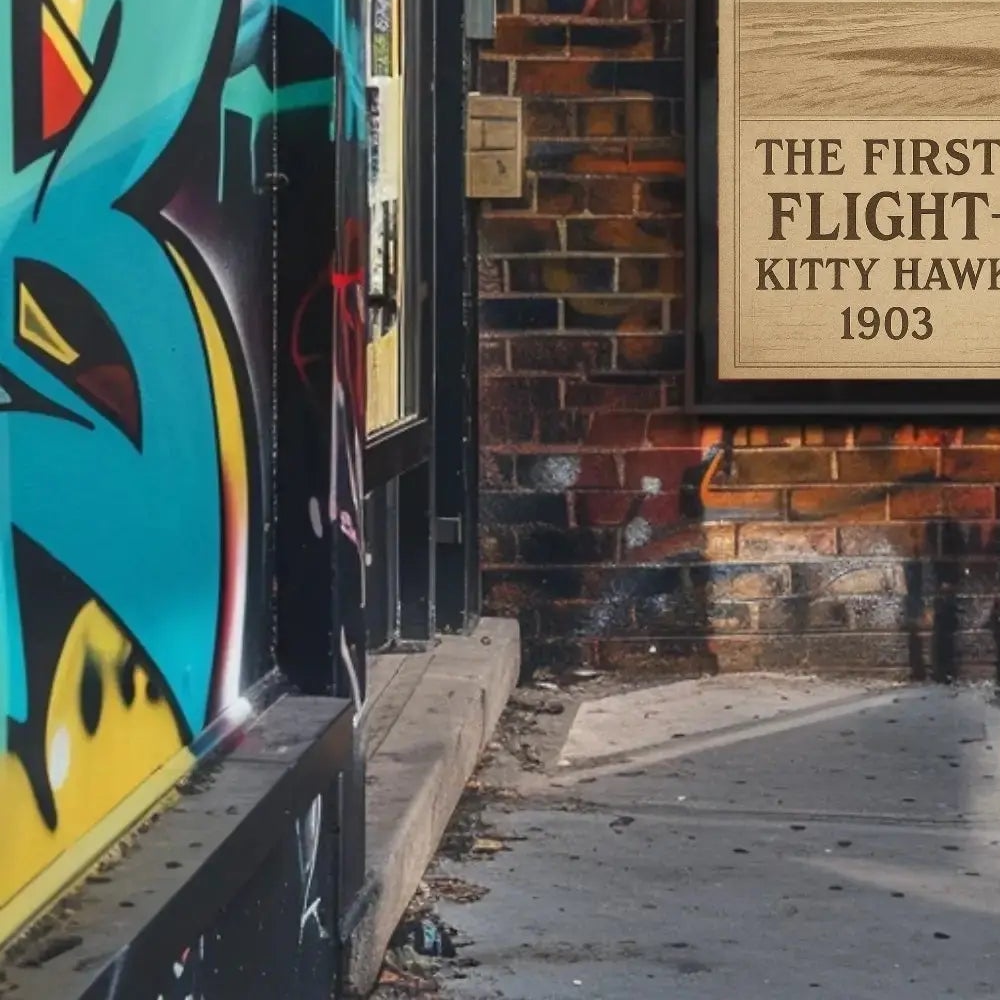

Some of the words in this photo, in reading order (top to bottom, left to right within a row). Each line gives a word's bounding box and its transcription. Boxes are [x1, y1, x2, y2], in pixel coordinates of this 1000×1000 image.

[755, 138, 846, 176] THE
[755, 257, 881, 291] KITTY
[840, 306, 934, 341] 1903
